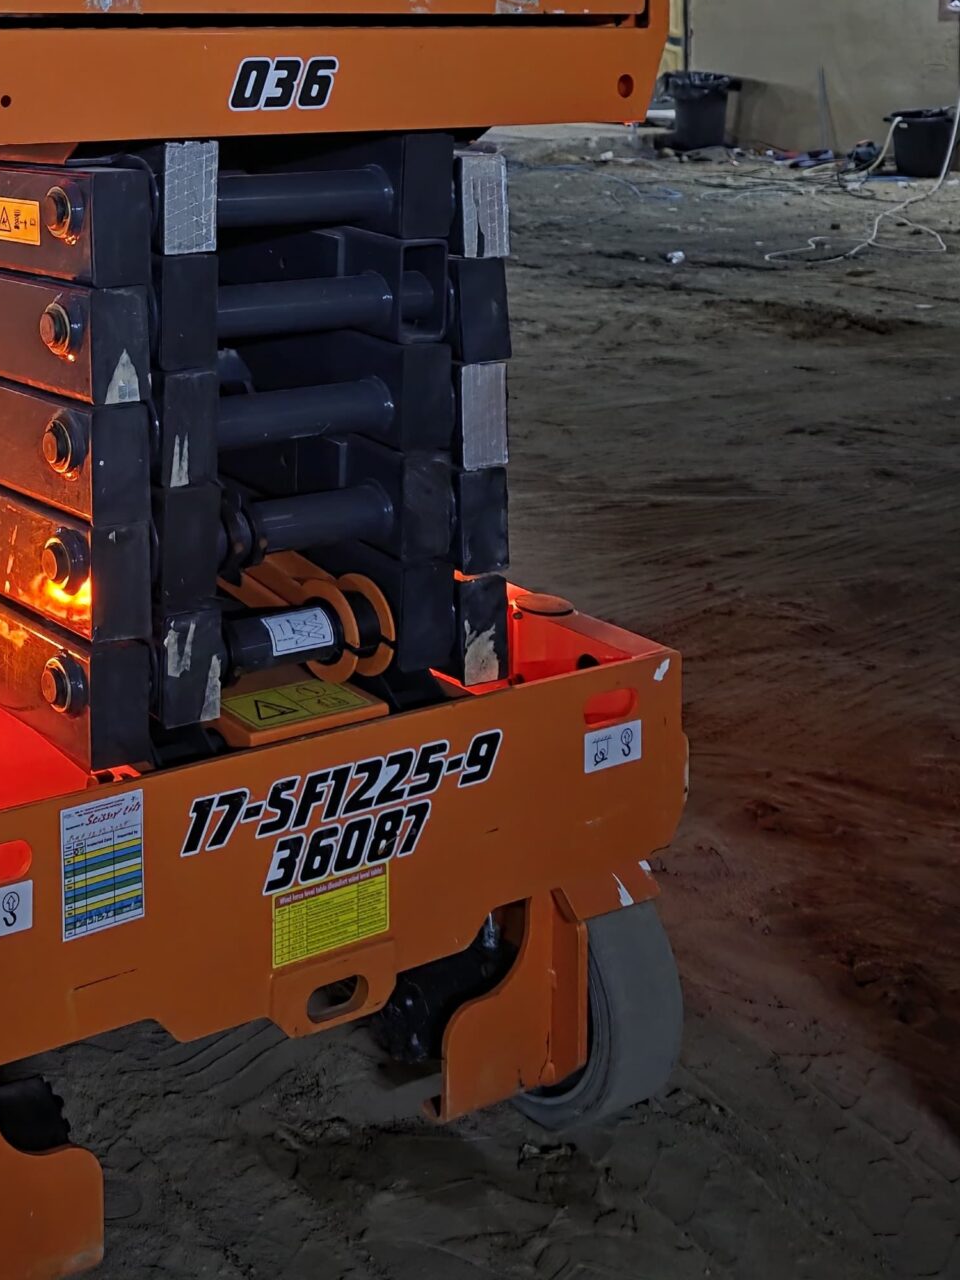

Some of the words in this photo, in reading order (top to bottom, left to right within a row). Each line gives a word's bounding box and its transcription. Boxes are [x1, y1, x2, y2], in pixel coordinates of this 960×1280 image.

[228, 56, 339, 111] 036
[180, 729, 503, 858] 17-SF1225-9
[262, 799, 432, 896] 36087
